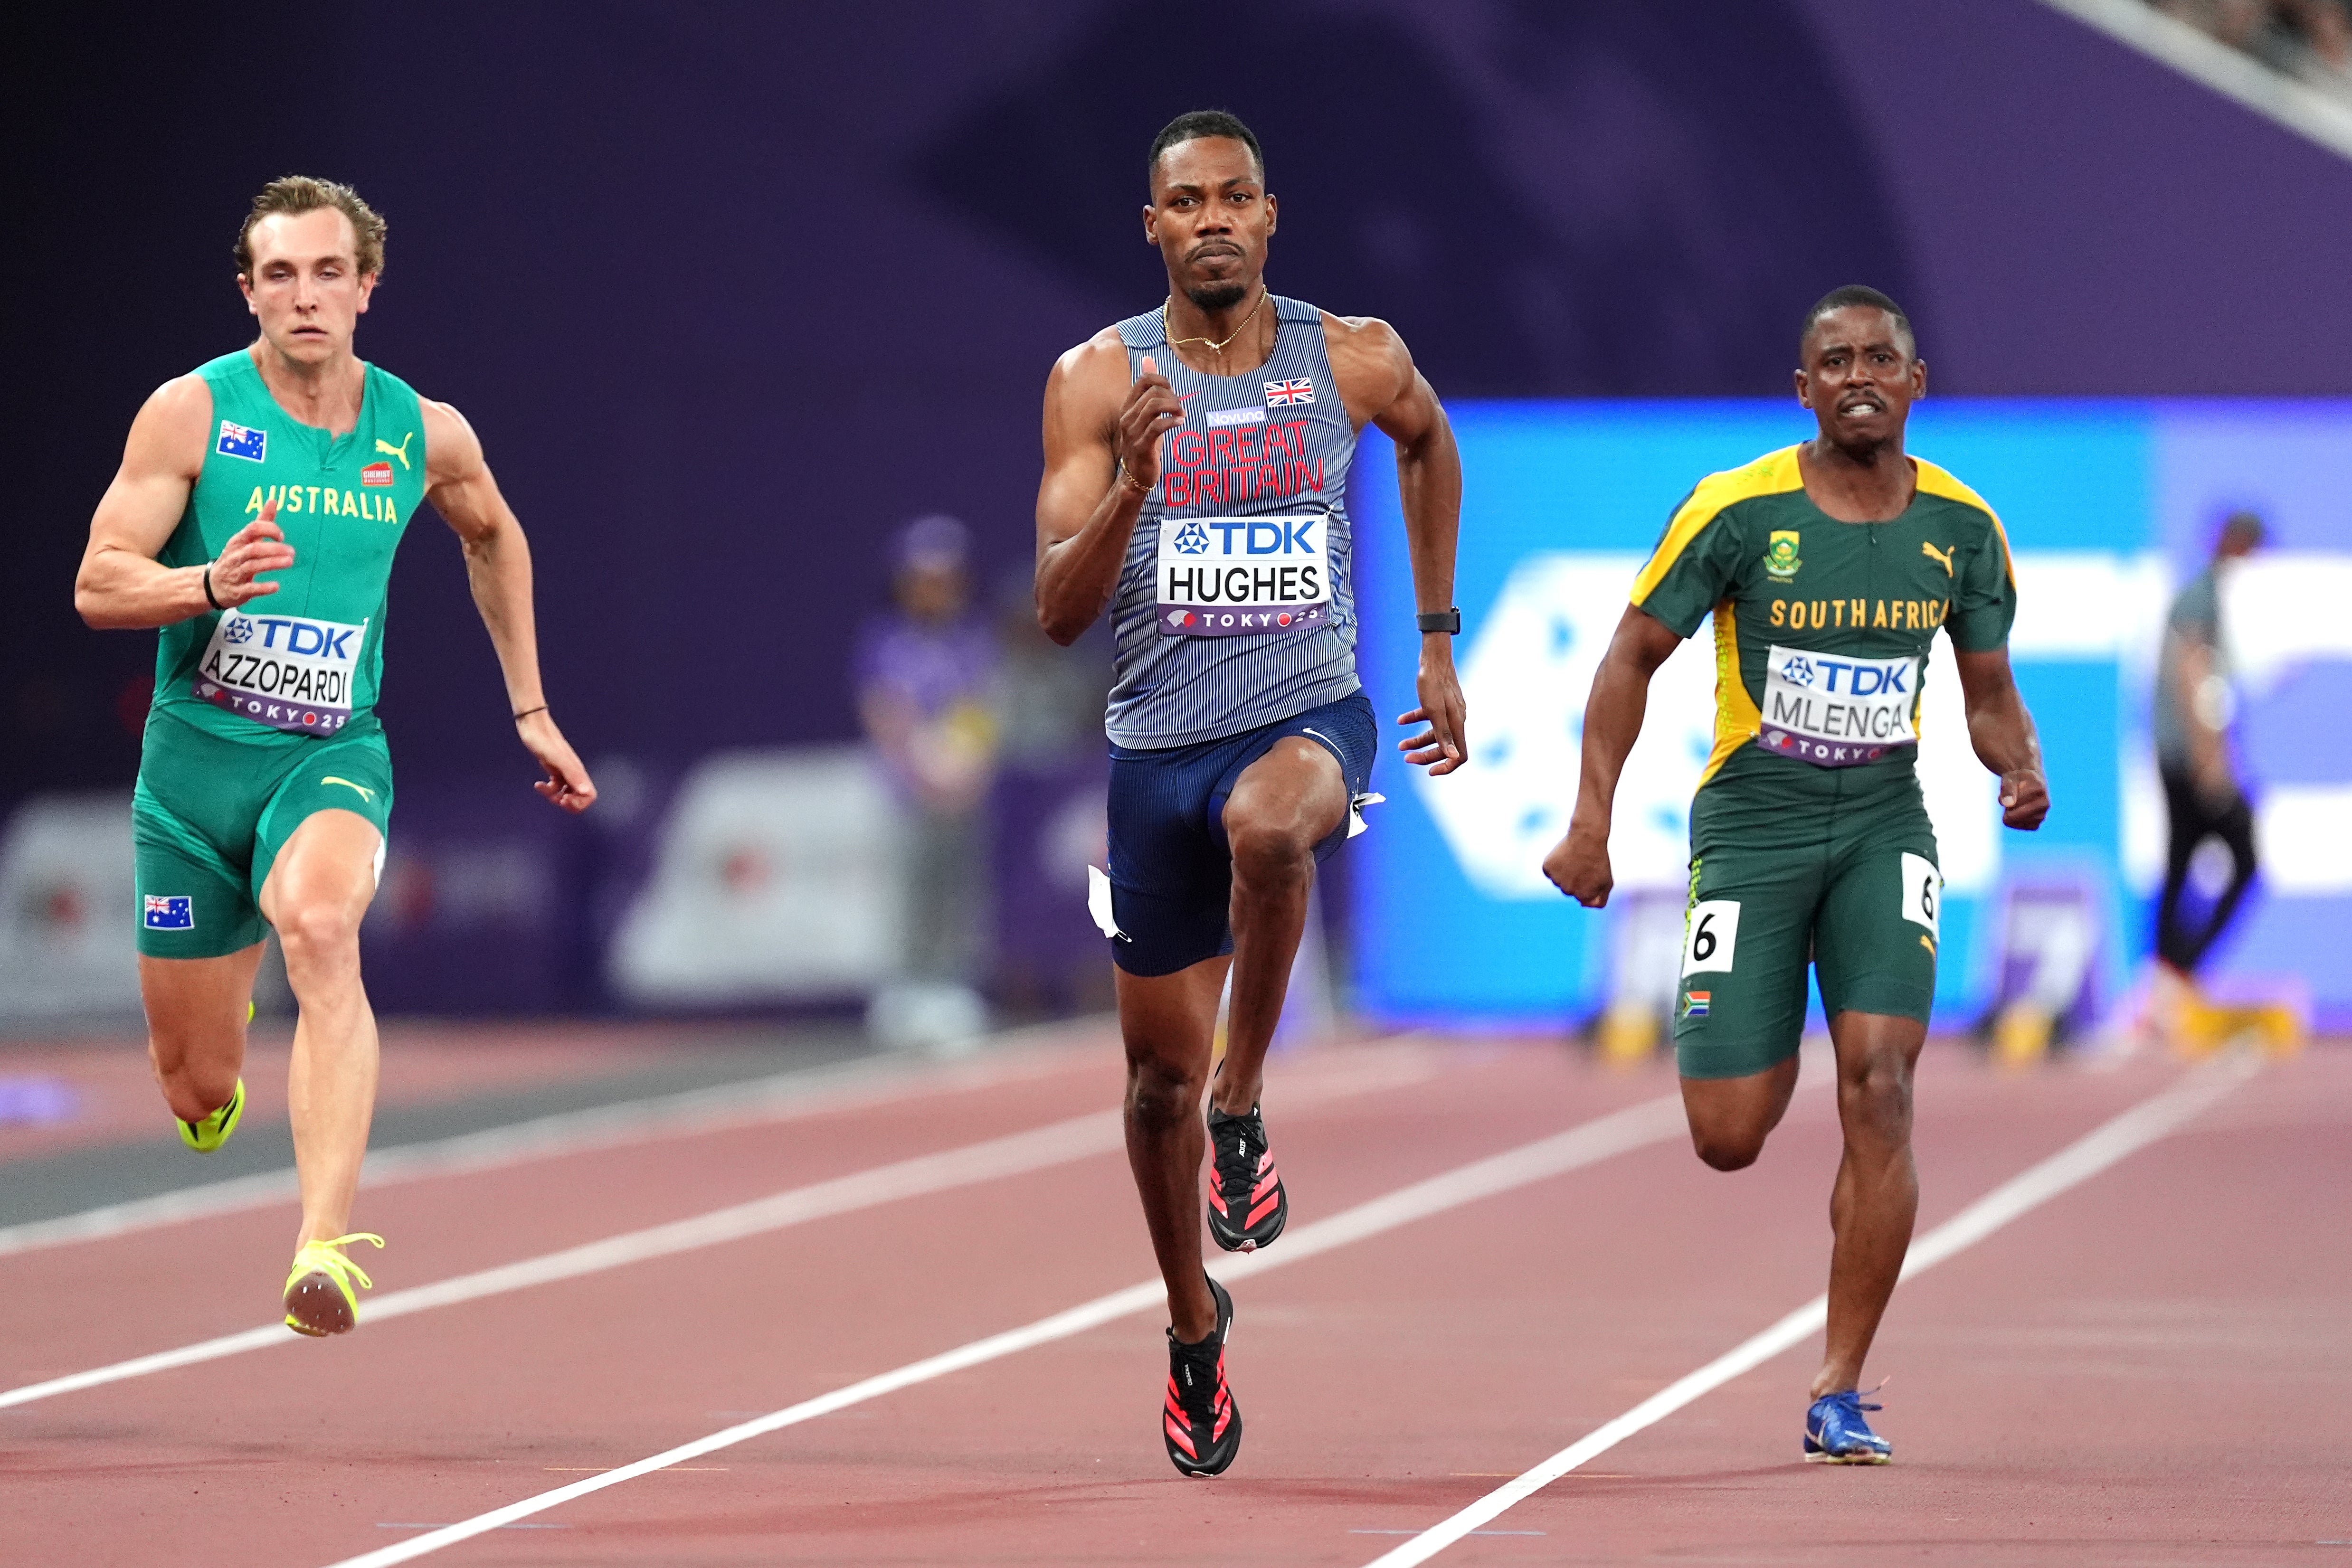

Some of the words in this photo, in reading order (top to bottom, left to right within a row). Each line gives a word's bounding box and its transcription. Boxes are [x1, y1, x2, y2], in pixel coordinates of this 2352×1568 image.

[1208, 410, 1264, 425] Novuna
[1172, 420, 1308, 467] GREAT
[1165, 458, 1323, 507] BRITAIN
[245, 485, 397, 524] AUSTRALIA
[1209, 521, 1316, 555] TDK
[1169, 566, 1320, 602] HUGHES
[1770, 599, 1866, 629] SOUTH
[257, 619, 355, 659] TDK
[205, 649, 346, 704] AZZOPARDI
[1817, 659, 1909, 695] TDK
[1773, 691, 1906, 737] MLENGA
[1921, 877, 1935, 920] 6
[1694, 913, 1716, 961] 6
